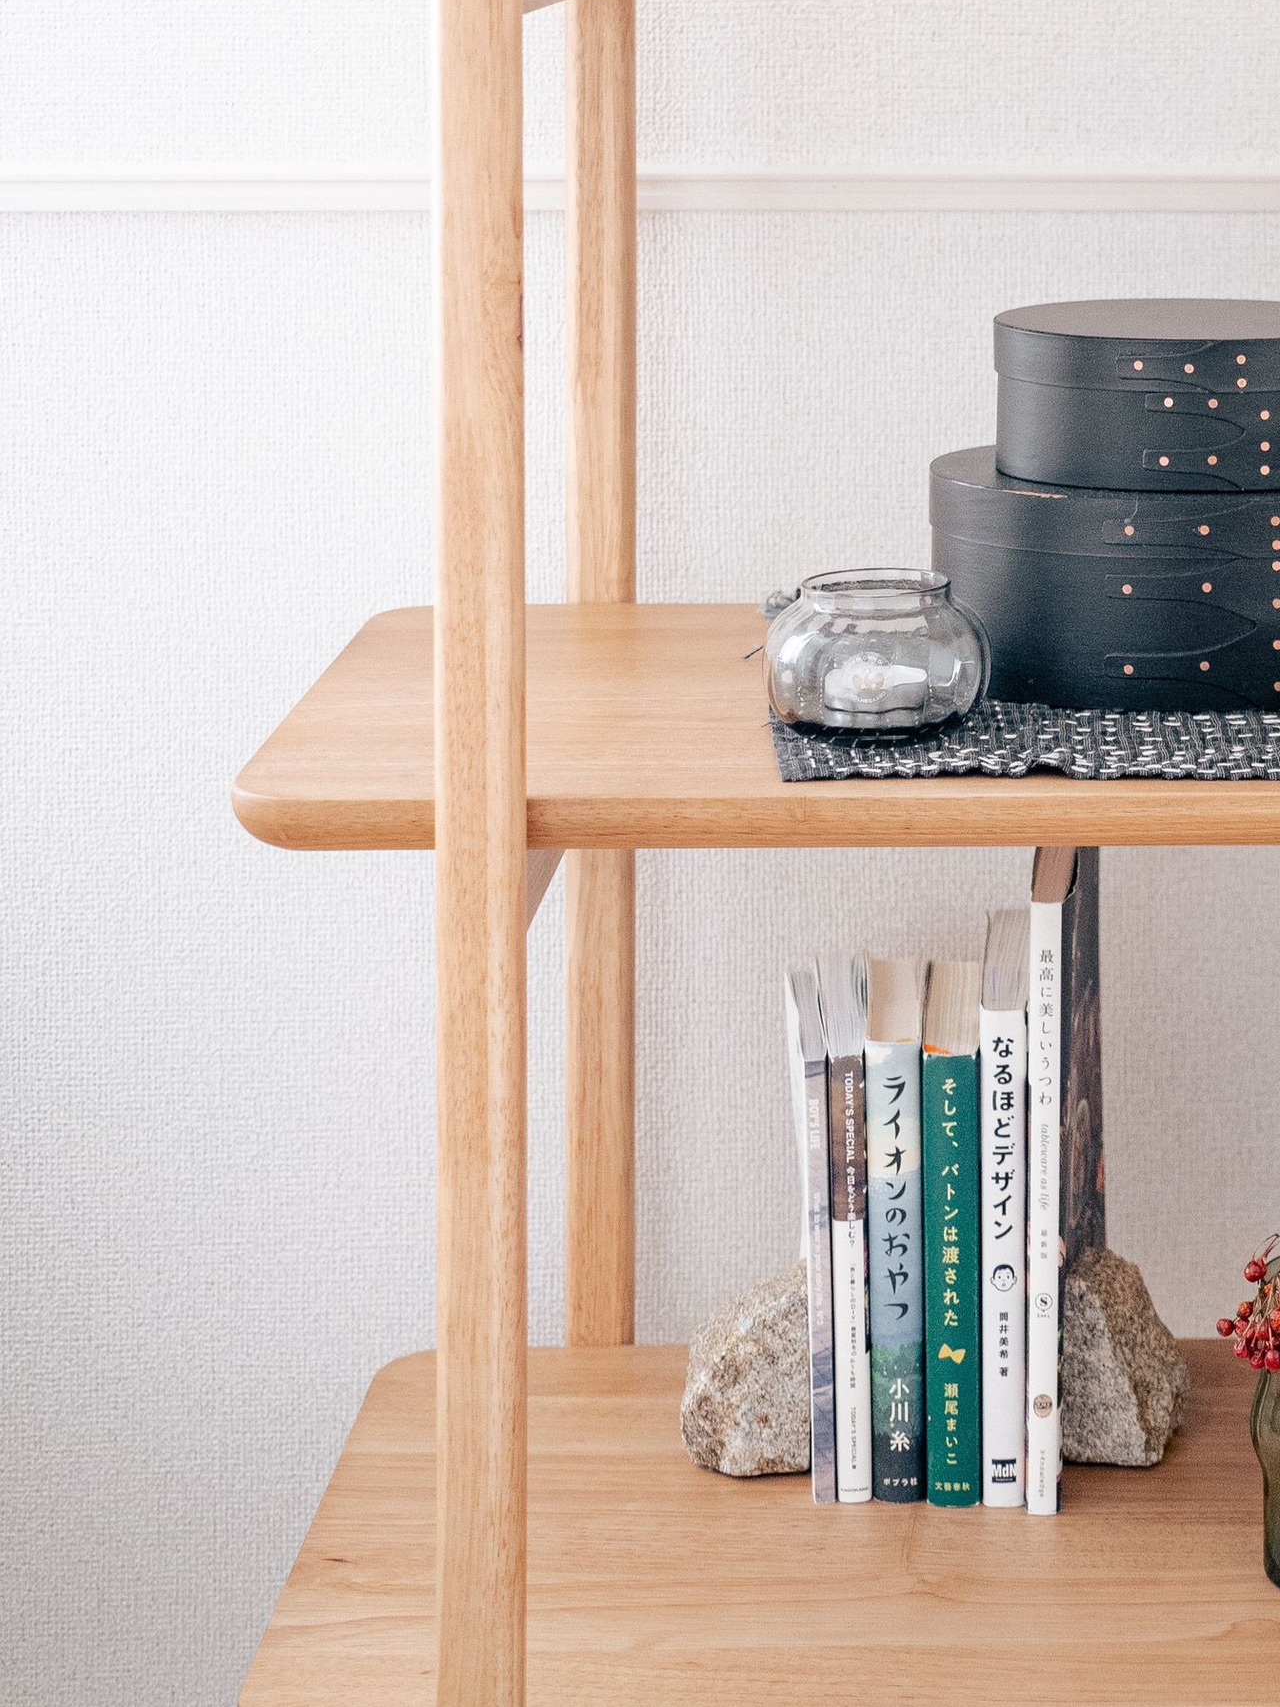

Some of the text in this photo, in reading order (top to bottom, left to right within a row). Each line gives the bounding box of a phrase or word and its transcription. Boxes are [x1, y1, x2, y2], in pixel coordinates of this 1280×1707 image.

[1038, 949, 1054, 1105] 最高に美しいうつわ
[808, 1098, 821, 1150] BOY'S LIFE
[844, 1070, 856, 1163] TODAY'S SPECIAL
[991, 1036, 1016, 1240] なるほどデザイン
[813, 1192, 821, 1213] What
[882, 1075, 909, 1321] ライオンのおやつ
[941, 1078, 960, 1327] そして、バトンは渡された
[1038, 1123, 1050, 1211] tableware as life
[889, 1378, 910, 1452] 小川糸
[944, 1383, 959, 1465] 瀬尾まいこ
[883, 1477, 918, 1486] ポプラ社
[992, 1463, 1017, 1478] MdN
